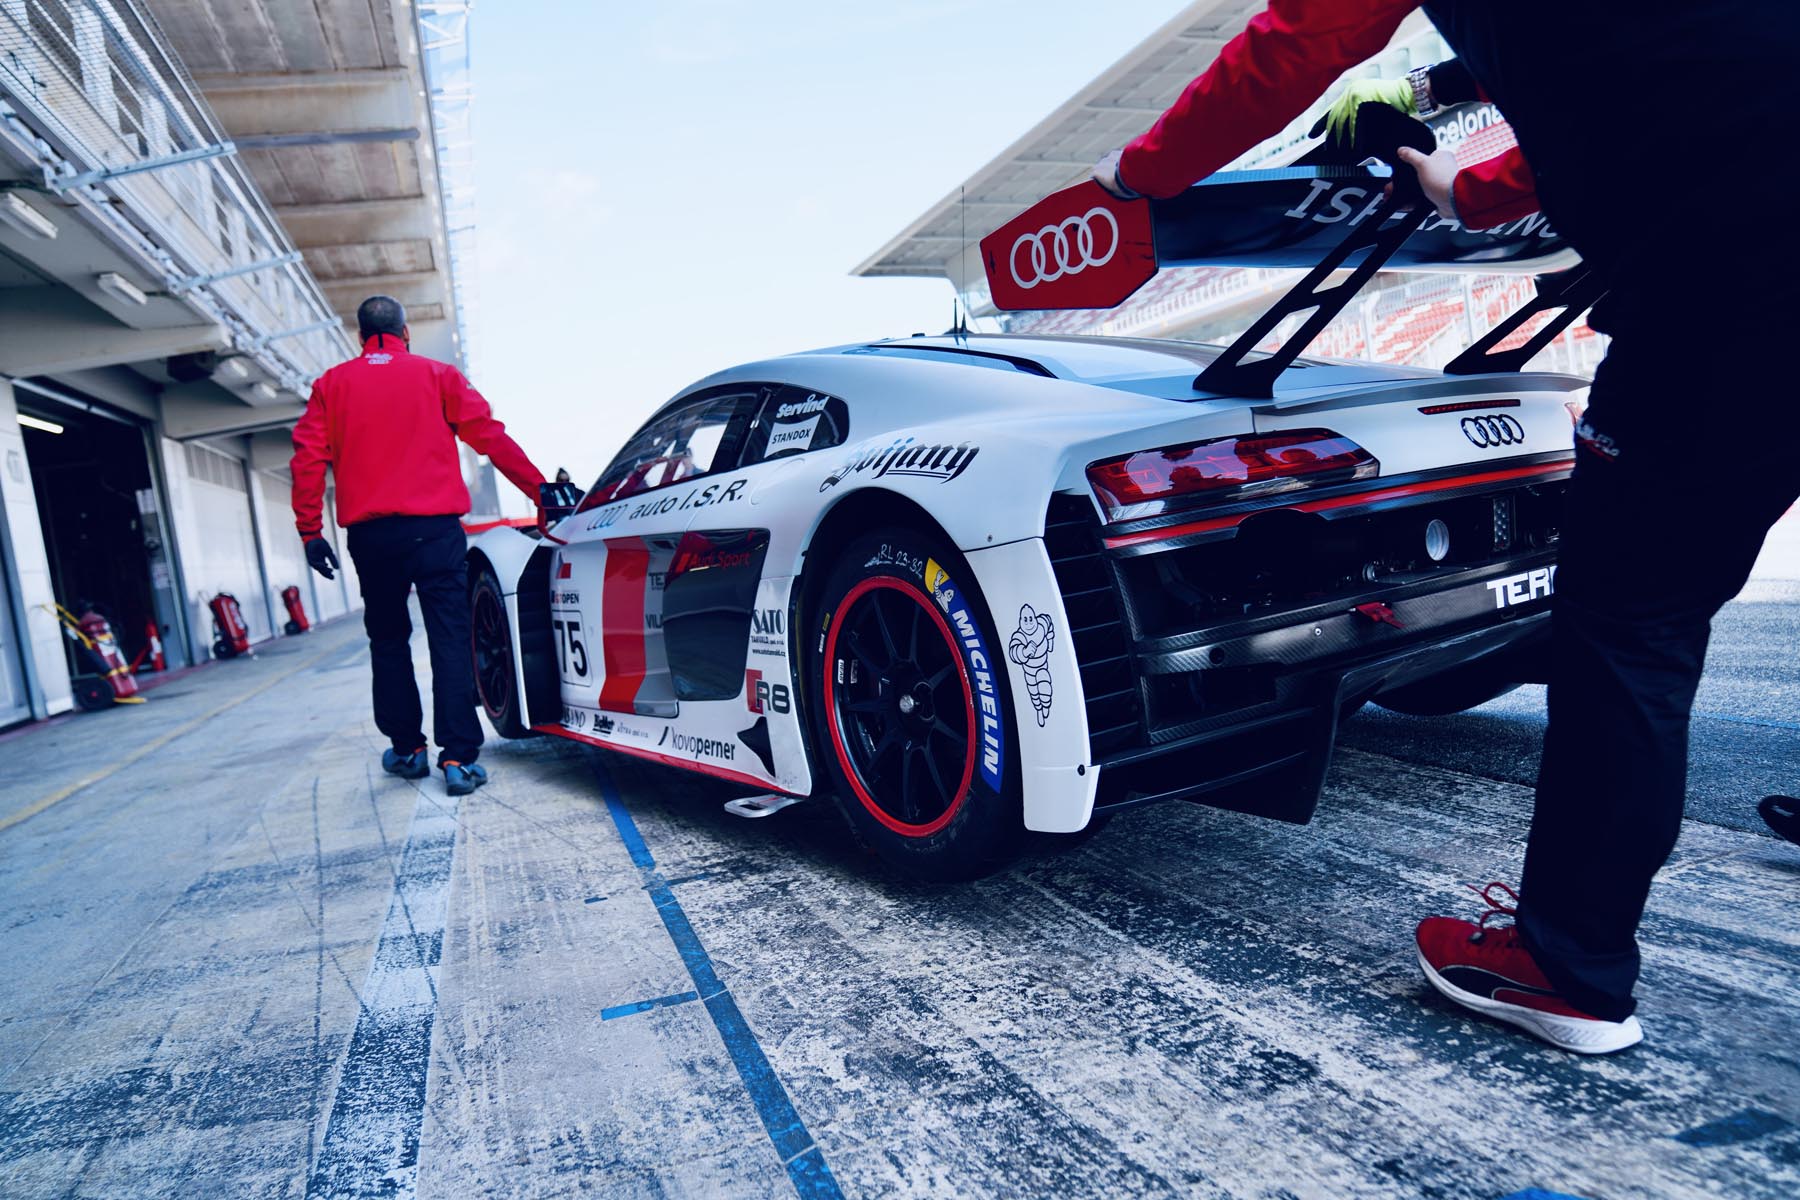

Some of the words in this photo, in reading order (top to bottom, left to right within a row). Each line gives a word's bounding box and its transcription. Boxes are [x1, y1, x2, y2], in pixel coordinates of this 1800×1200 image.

[771, 428, 811, 445] STANDOX
[629, 495, 678, 520] auto
[679, 479, 748, 511] I.S.R.
[718, 551, 751, 569] Sport
[752, 608, 786, 635] SATO
[554, 620, 588, 677] 75
[756, 680, 791, 715] R8
[952, 609, 999, 776] MICHELIN
[671, 726, 736, 761] kovoperner
